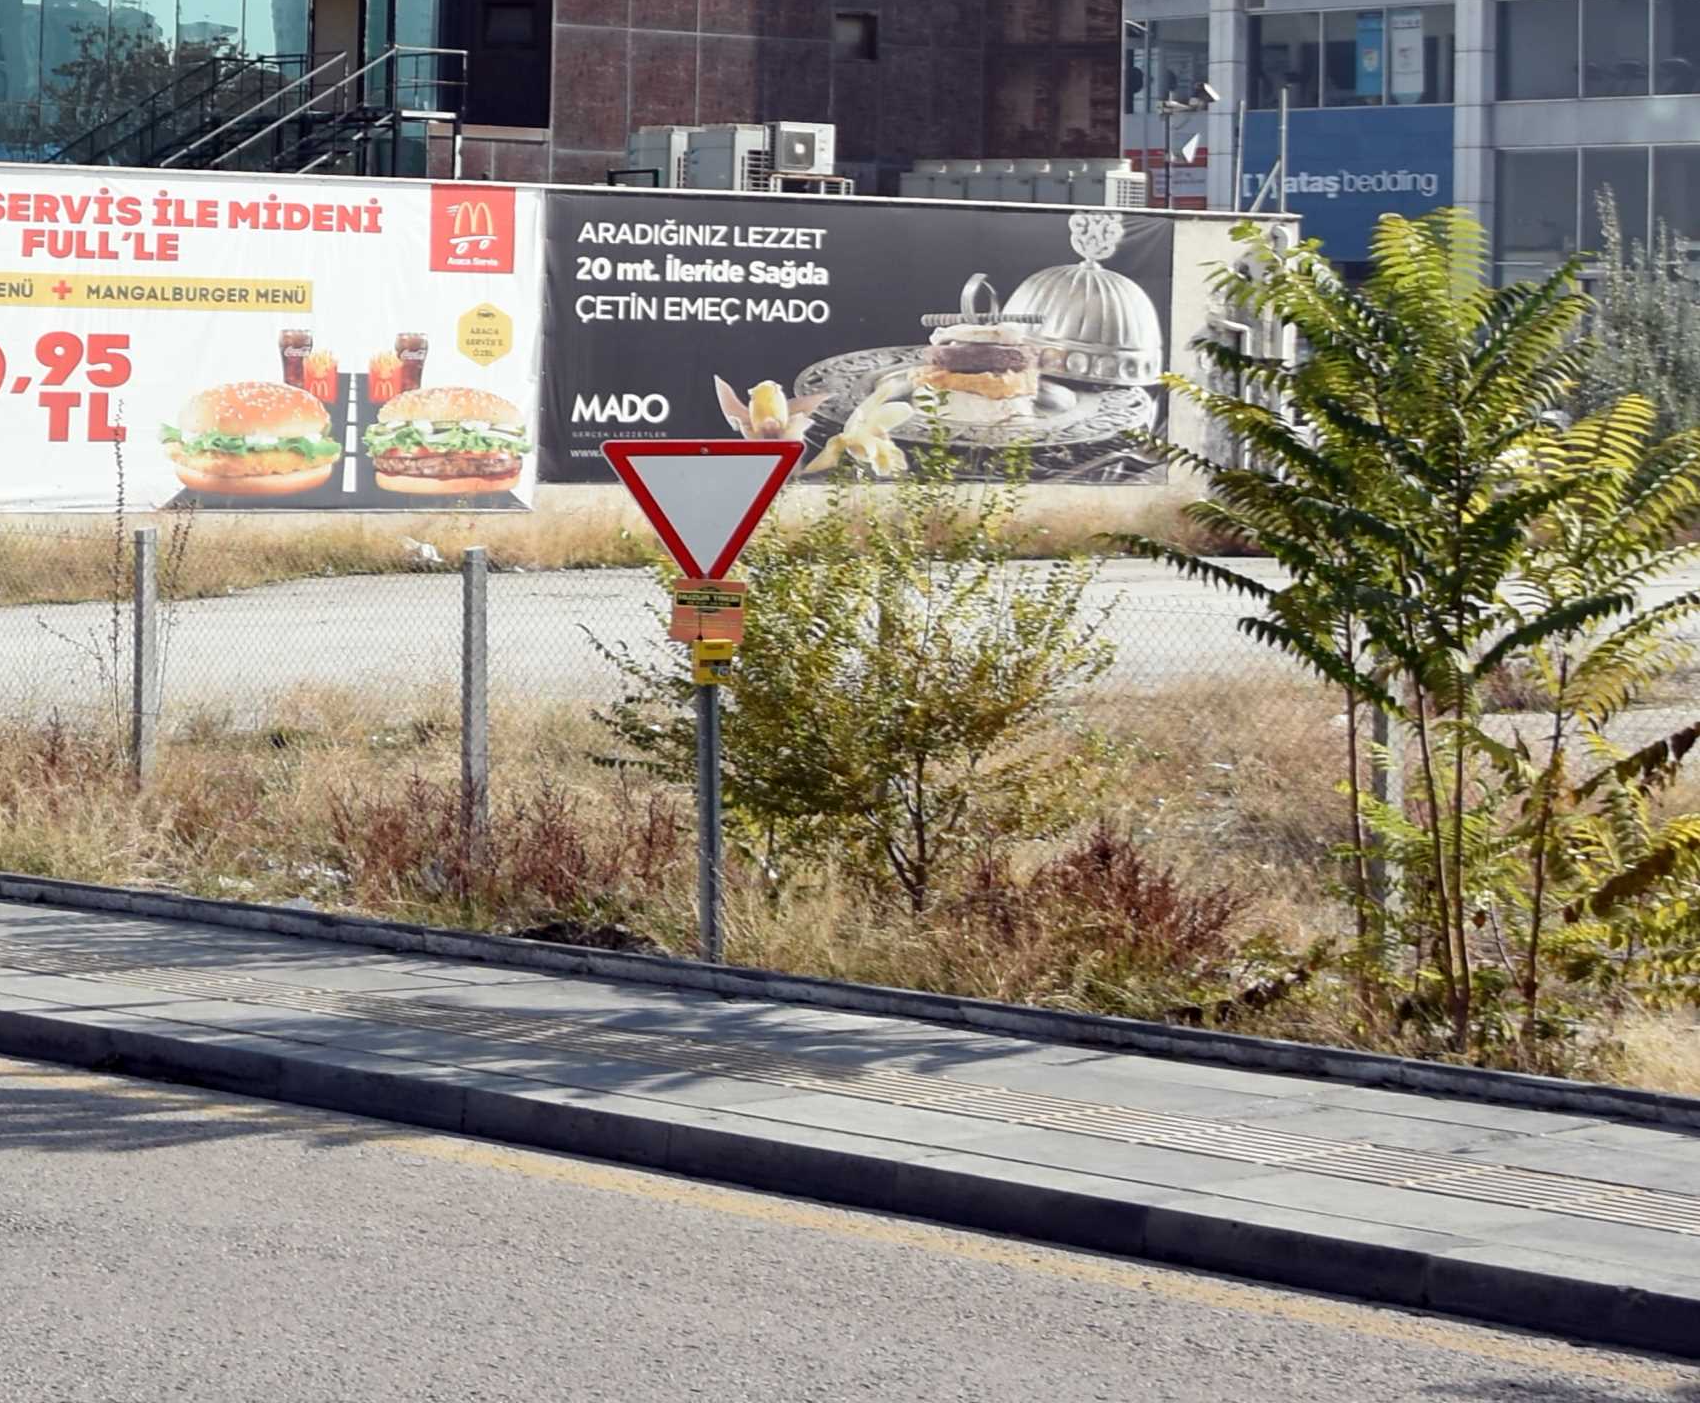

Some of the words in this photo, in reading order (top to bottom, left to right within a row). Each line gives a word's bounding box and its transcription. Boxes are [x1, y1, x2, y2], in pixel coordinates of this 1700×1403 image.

[1342, 169, 1438, 196] bedding
[153, 189, 220, 229] İLE
[229, 193, 383, 234] MİDENİ
[577, 219, 728, 247] ARADIĞINIZ
[734, 225, 827, 249] LEZZET
[575, 256, 611, 280] 20
[617, 259, 660, 282] mt.
[665, 254, 745, 283] İleride
[749, 260, 829, 289] Sağda
[86, 283, 249, 304] MANGALBURGER
[256, 285, 306, 305] MENÜ
[575, 292, 657, 324] ÇETİN
[664, 297, 742, 326] EMEÇ
[746, 299, 830, 324] MADO
[39, 391, 131, 442] TL
[571, 393, 670, 424] MADO
